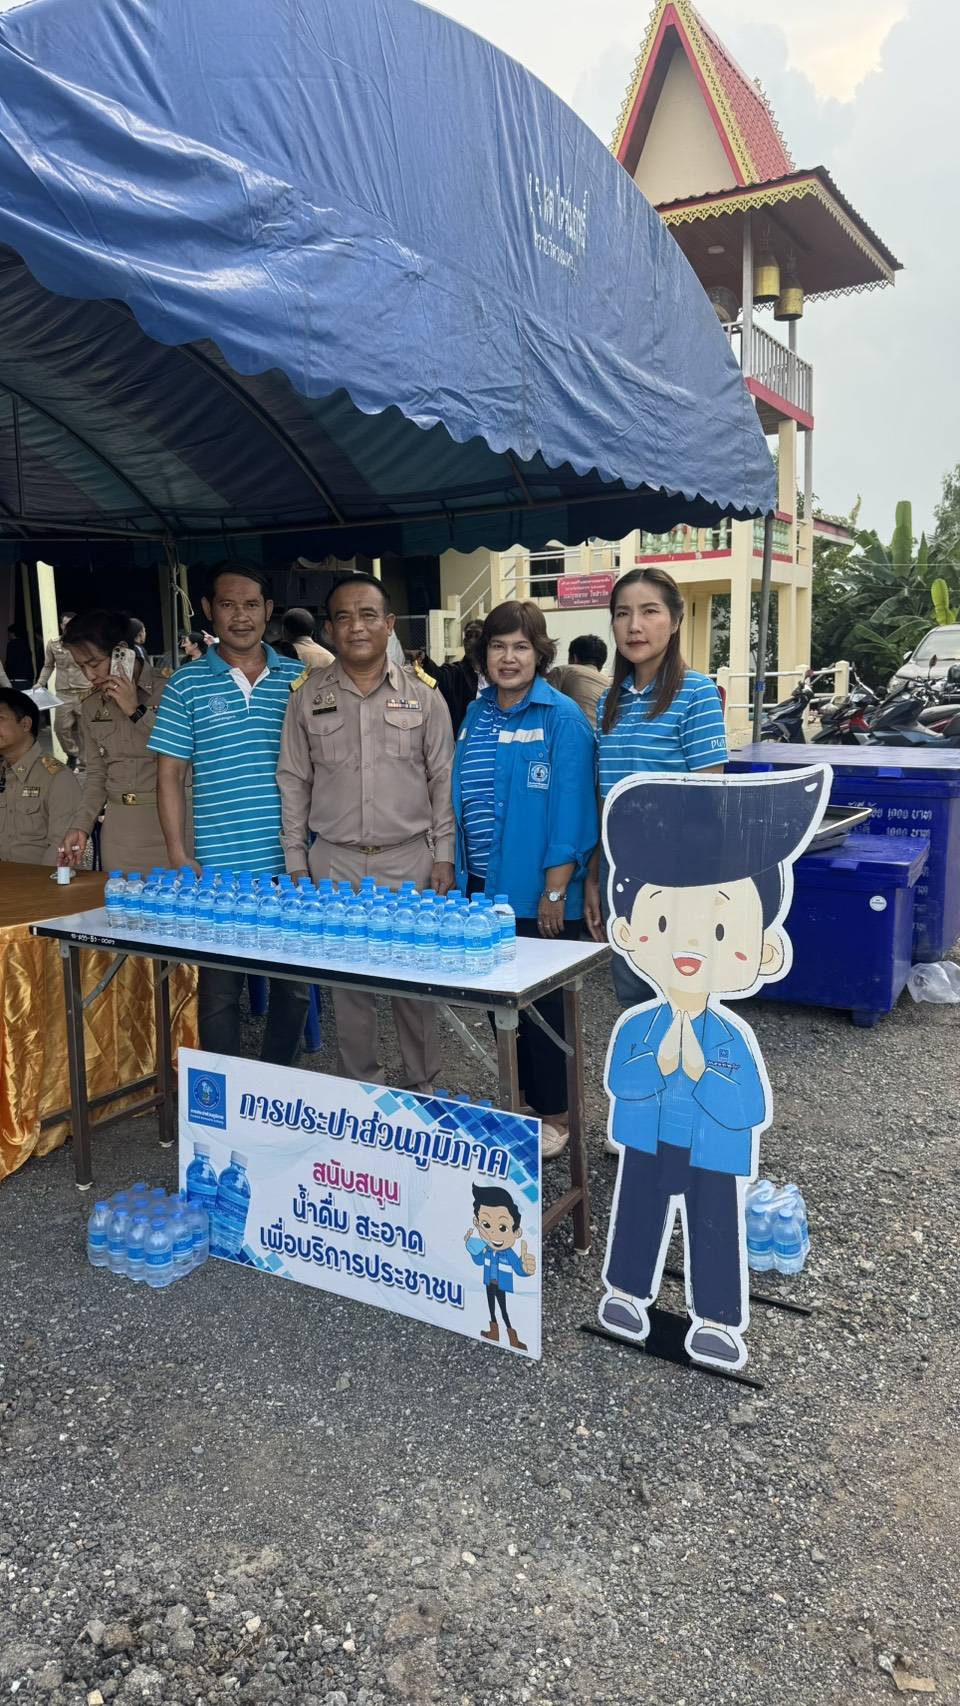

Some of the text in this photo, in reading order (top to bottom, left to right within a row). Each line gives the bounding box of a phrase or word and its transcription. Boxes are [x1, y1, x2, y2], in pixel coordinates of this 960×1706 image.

[239, 1091, 509, 1178] การประปาส่วนภูมิภาค
[293, 1184, 425, 1256] น้ำดื่ม สะอาด
[312, 1159, 399, 1206] สนับสนุน
[259, 1217, 465, 1309] เพื่อบริการประชาชน
